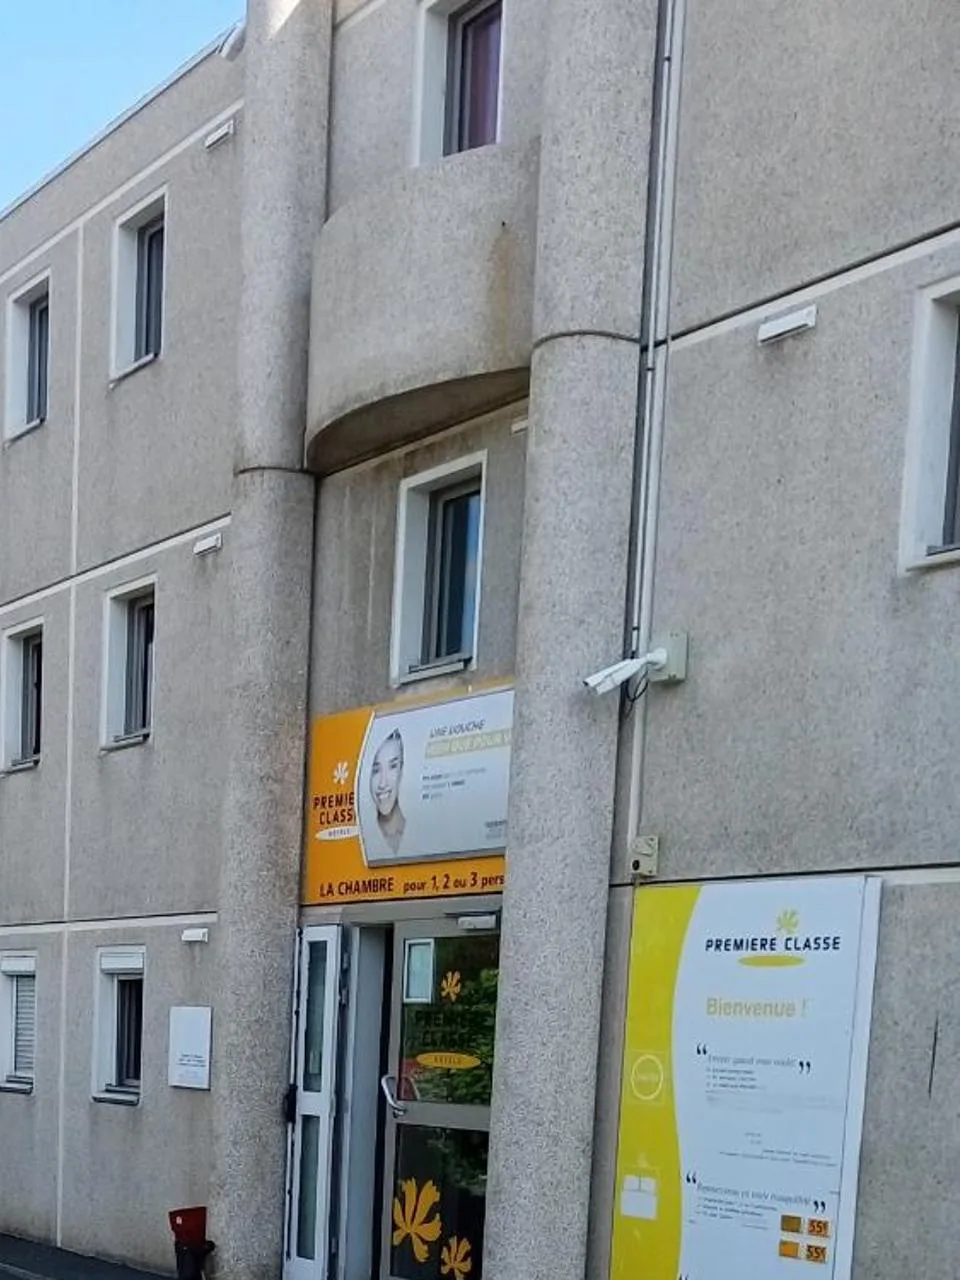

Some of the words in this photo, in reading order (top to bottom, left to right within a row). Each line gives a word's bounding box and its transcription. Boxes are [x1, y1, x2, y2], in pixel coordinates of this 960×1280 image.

[319, 882, 335, 898] LA
[337, 877, 395, 896] CHAMBRE
[403, 881, 428, 894] pour
[442, 874, 451, 889] 2
[453, 878, 466, 889] ou
[470, 872, 479, 887] 3
[705, 937, 777, 952] PREMIERE
[784, 936, 841, 951] CLASSE
[706, 998, 797, 1017] Bienvenue
